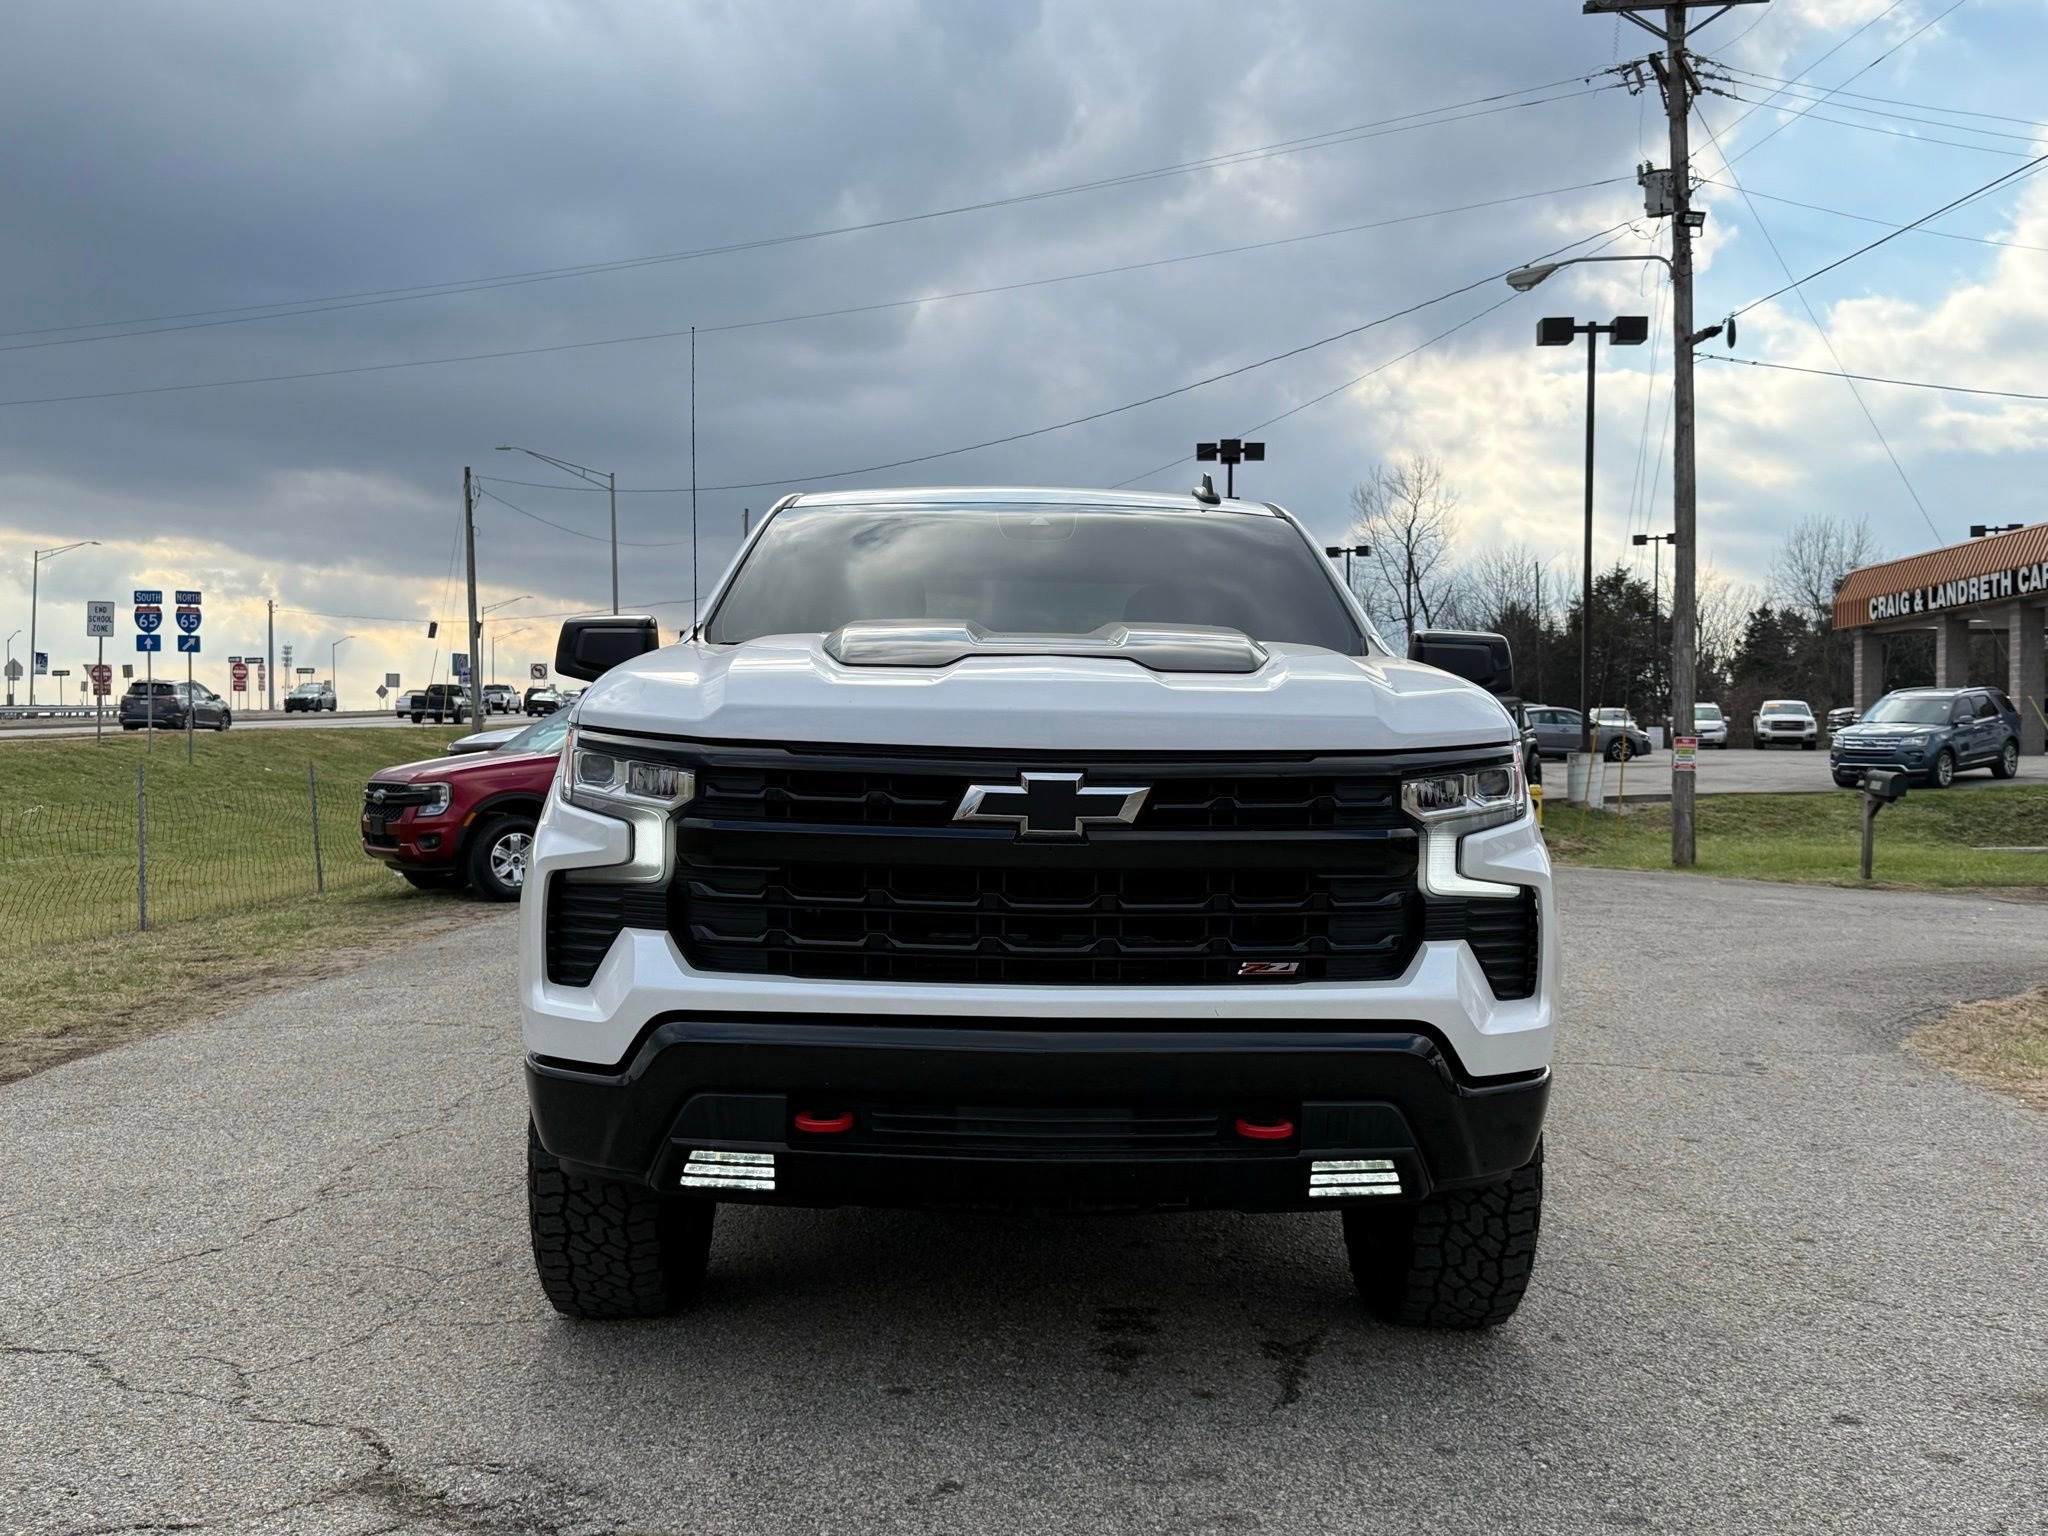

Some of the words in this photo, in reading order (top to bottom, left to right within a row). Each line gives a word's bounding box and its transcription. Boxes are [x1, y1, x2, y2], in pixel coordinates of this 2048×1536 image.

[135, 592, 161, 602] SOUTH
[176, 592, 200, 602] NORTH
[1869, 591, 1910, 620] CRAIG
[1914, 588, 1923, 612] &
[1928, 570, 2012, 610] LANDRETH
[94, 606, 107, 614] END
[88, 615, 112, 624] SCHOOL
[140, 614, 158, 627] 65
[180, 614, 198, 628] 65
[92, 624, 108, 633] ZONE
[1237, 962, 1299, 975] Z71
